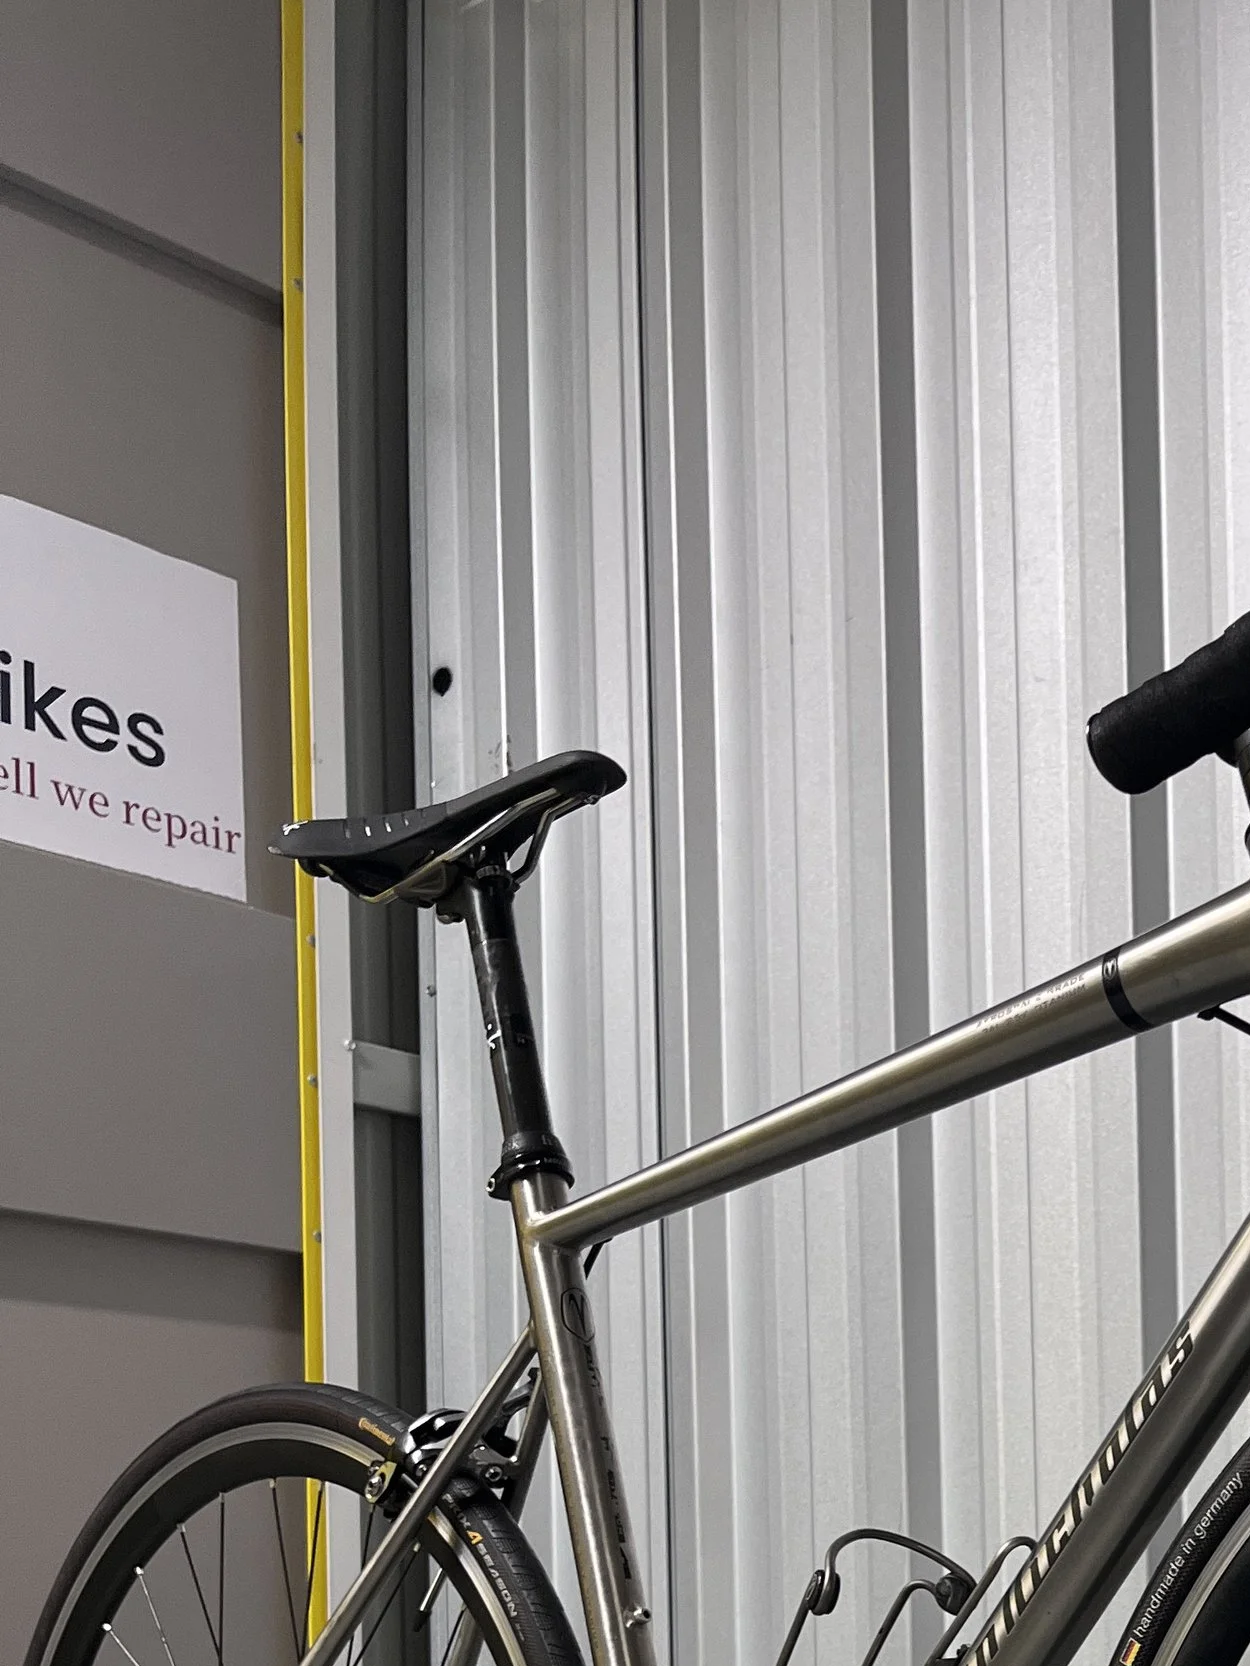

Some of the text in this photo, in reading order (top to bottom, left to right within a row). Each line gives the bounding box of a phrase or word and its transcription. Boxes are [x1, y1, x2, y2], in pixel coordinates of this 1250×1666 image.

[0, 650, 166, 768] ikes
[50, 779, 110, 818] we
[122, 799, 242, 855] repair
[1133, 1472, 1244, 1638] handmade in germany
